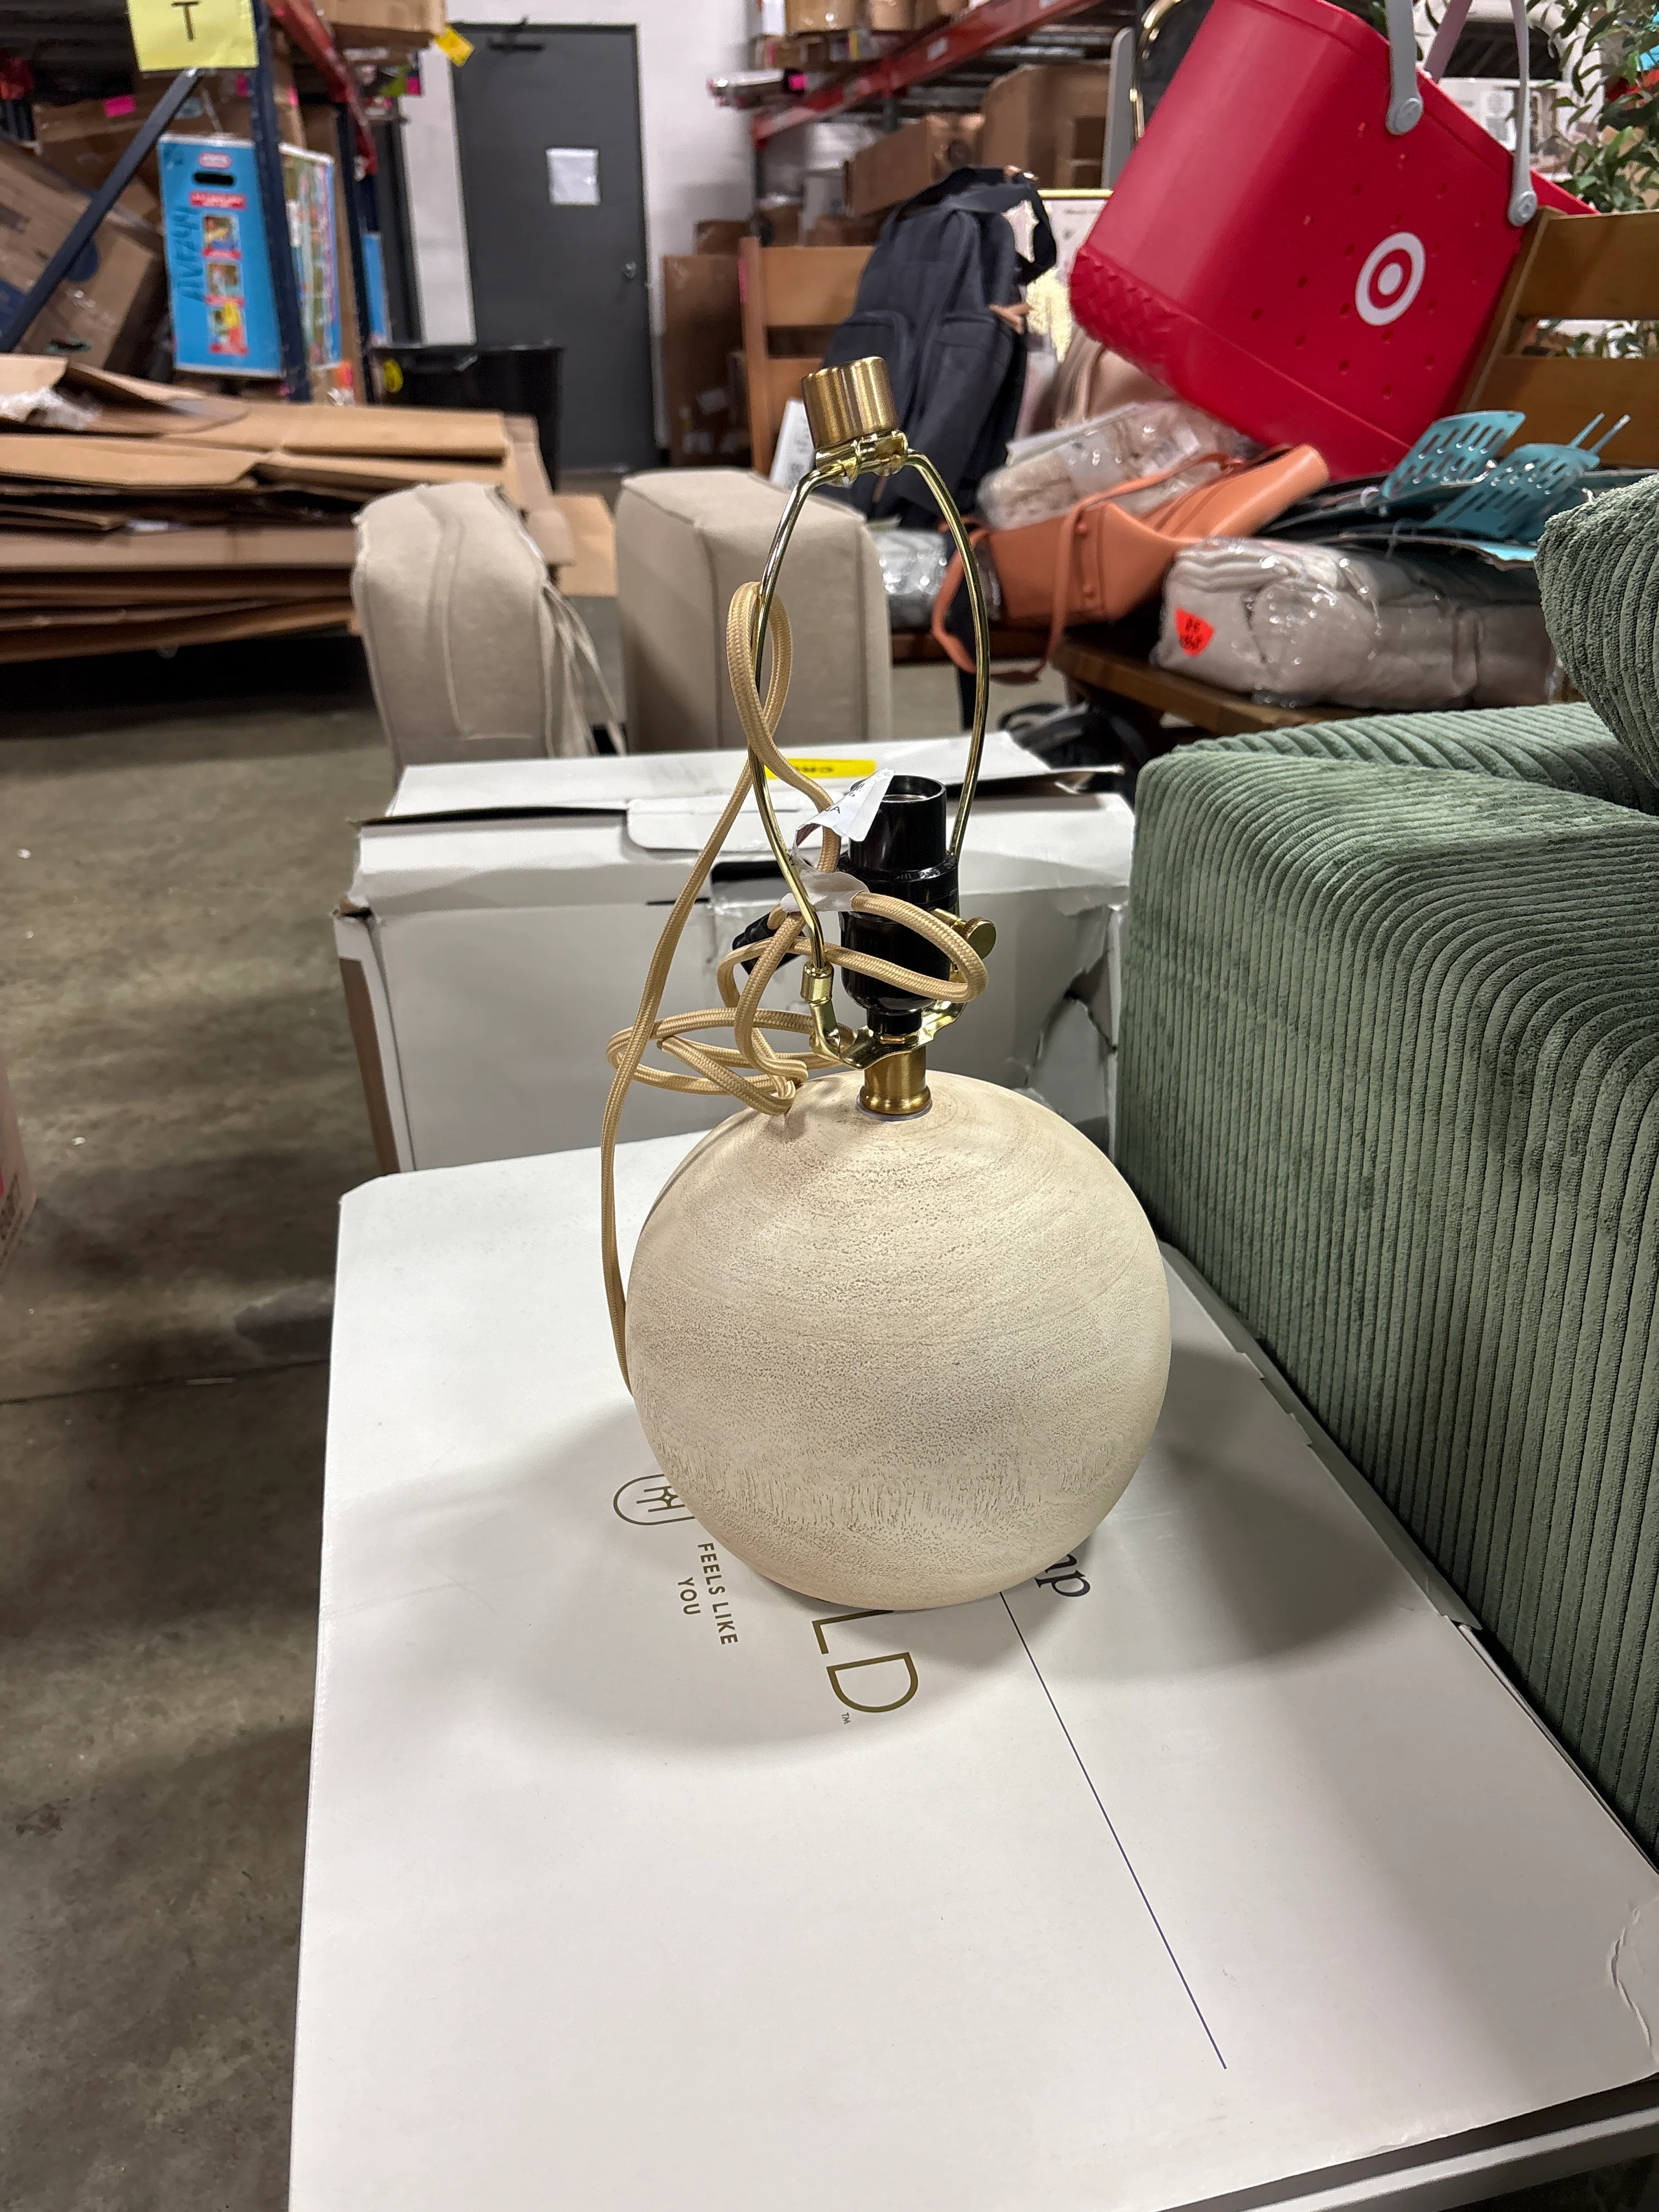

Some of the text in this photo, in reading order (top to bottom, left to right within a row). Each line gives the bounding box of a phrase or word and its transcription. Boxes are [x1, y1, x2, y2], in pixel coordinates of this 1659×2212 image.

[171, 1, 199, 41] T
[678, 1576, 701, 1615] YOU
[697, 1542, 738, 1645] FEELS LIKE
